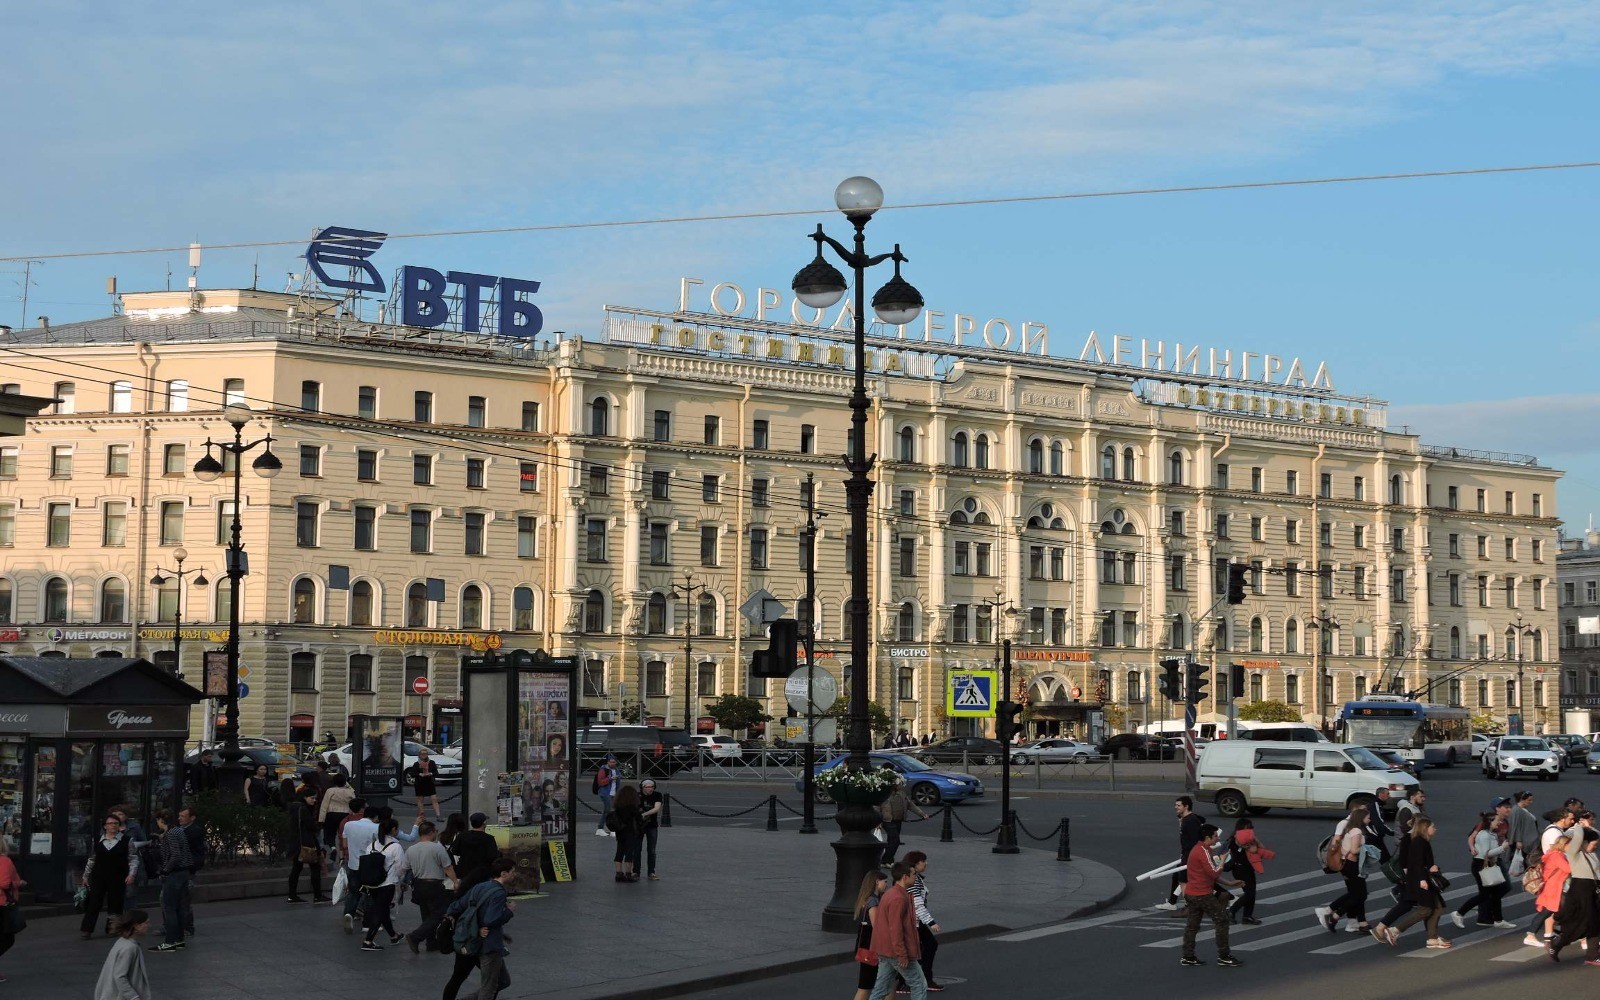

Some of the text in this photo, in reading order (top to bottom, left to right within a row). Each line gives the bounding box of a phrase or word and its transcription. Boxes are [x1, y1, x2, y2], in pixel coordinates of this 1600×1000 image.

[401, 265, 544, 337] ВТБ
[1079, 330, 1335, 391] ЛЕНИНГРАД
[1176, 386, 1365, 425] ОКТЯБРЬСКАЯ
[375, 629, 464, 645] СТОЛОВАЯ
[890, 648, 928, 658] БИСТРО
